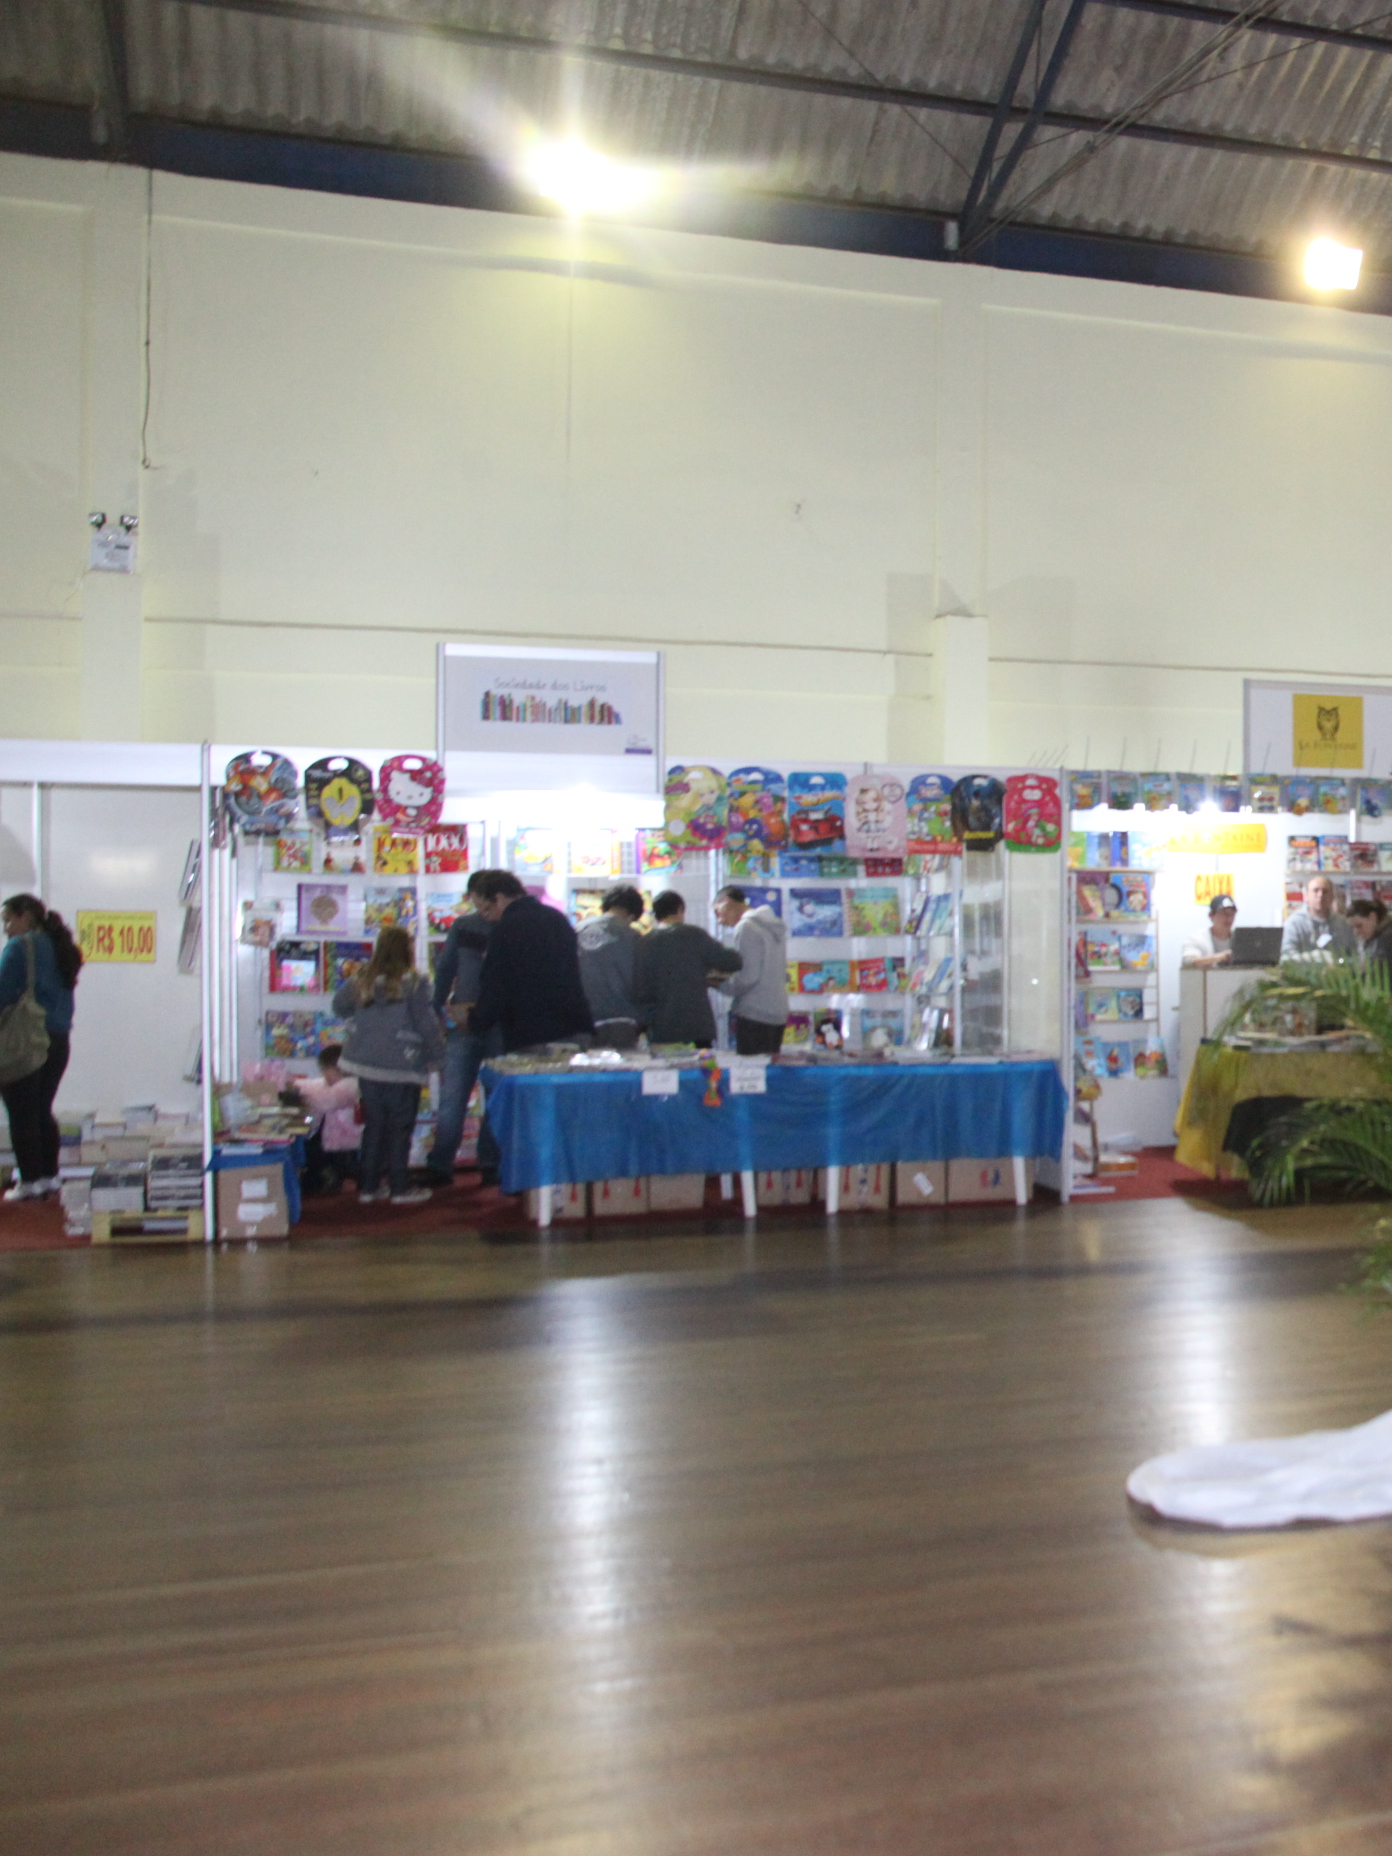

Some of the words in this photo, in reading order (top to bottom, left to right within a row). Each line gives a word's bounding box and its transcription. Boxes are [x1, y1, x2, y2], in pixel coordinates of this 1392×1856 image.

[1194, 875, 1233, 901] CAIXA
[96, 924, 115, 957] R$
[119, 925, 153, 959] 10,00
